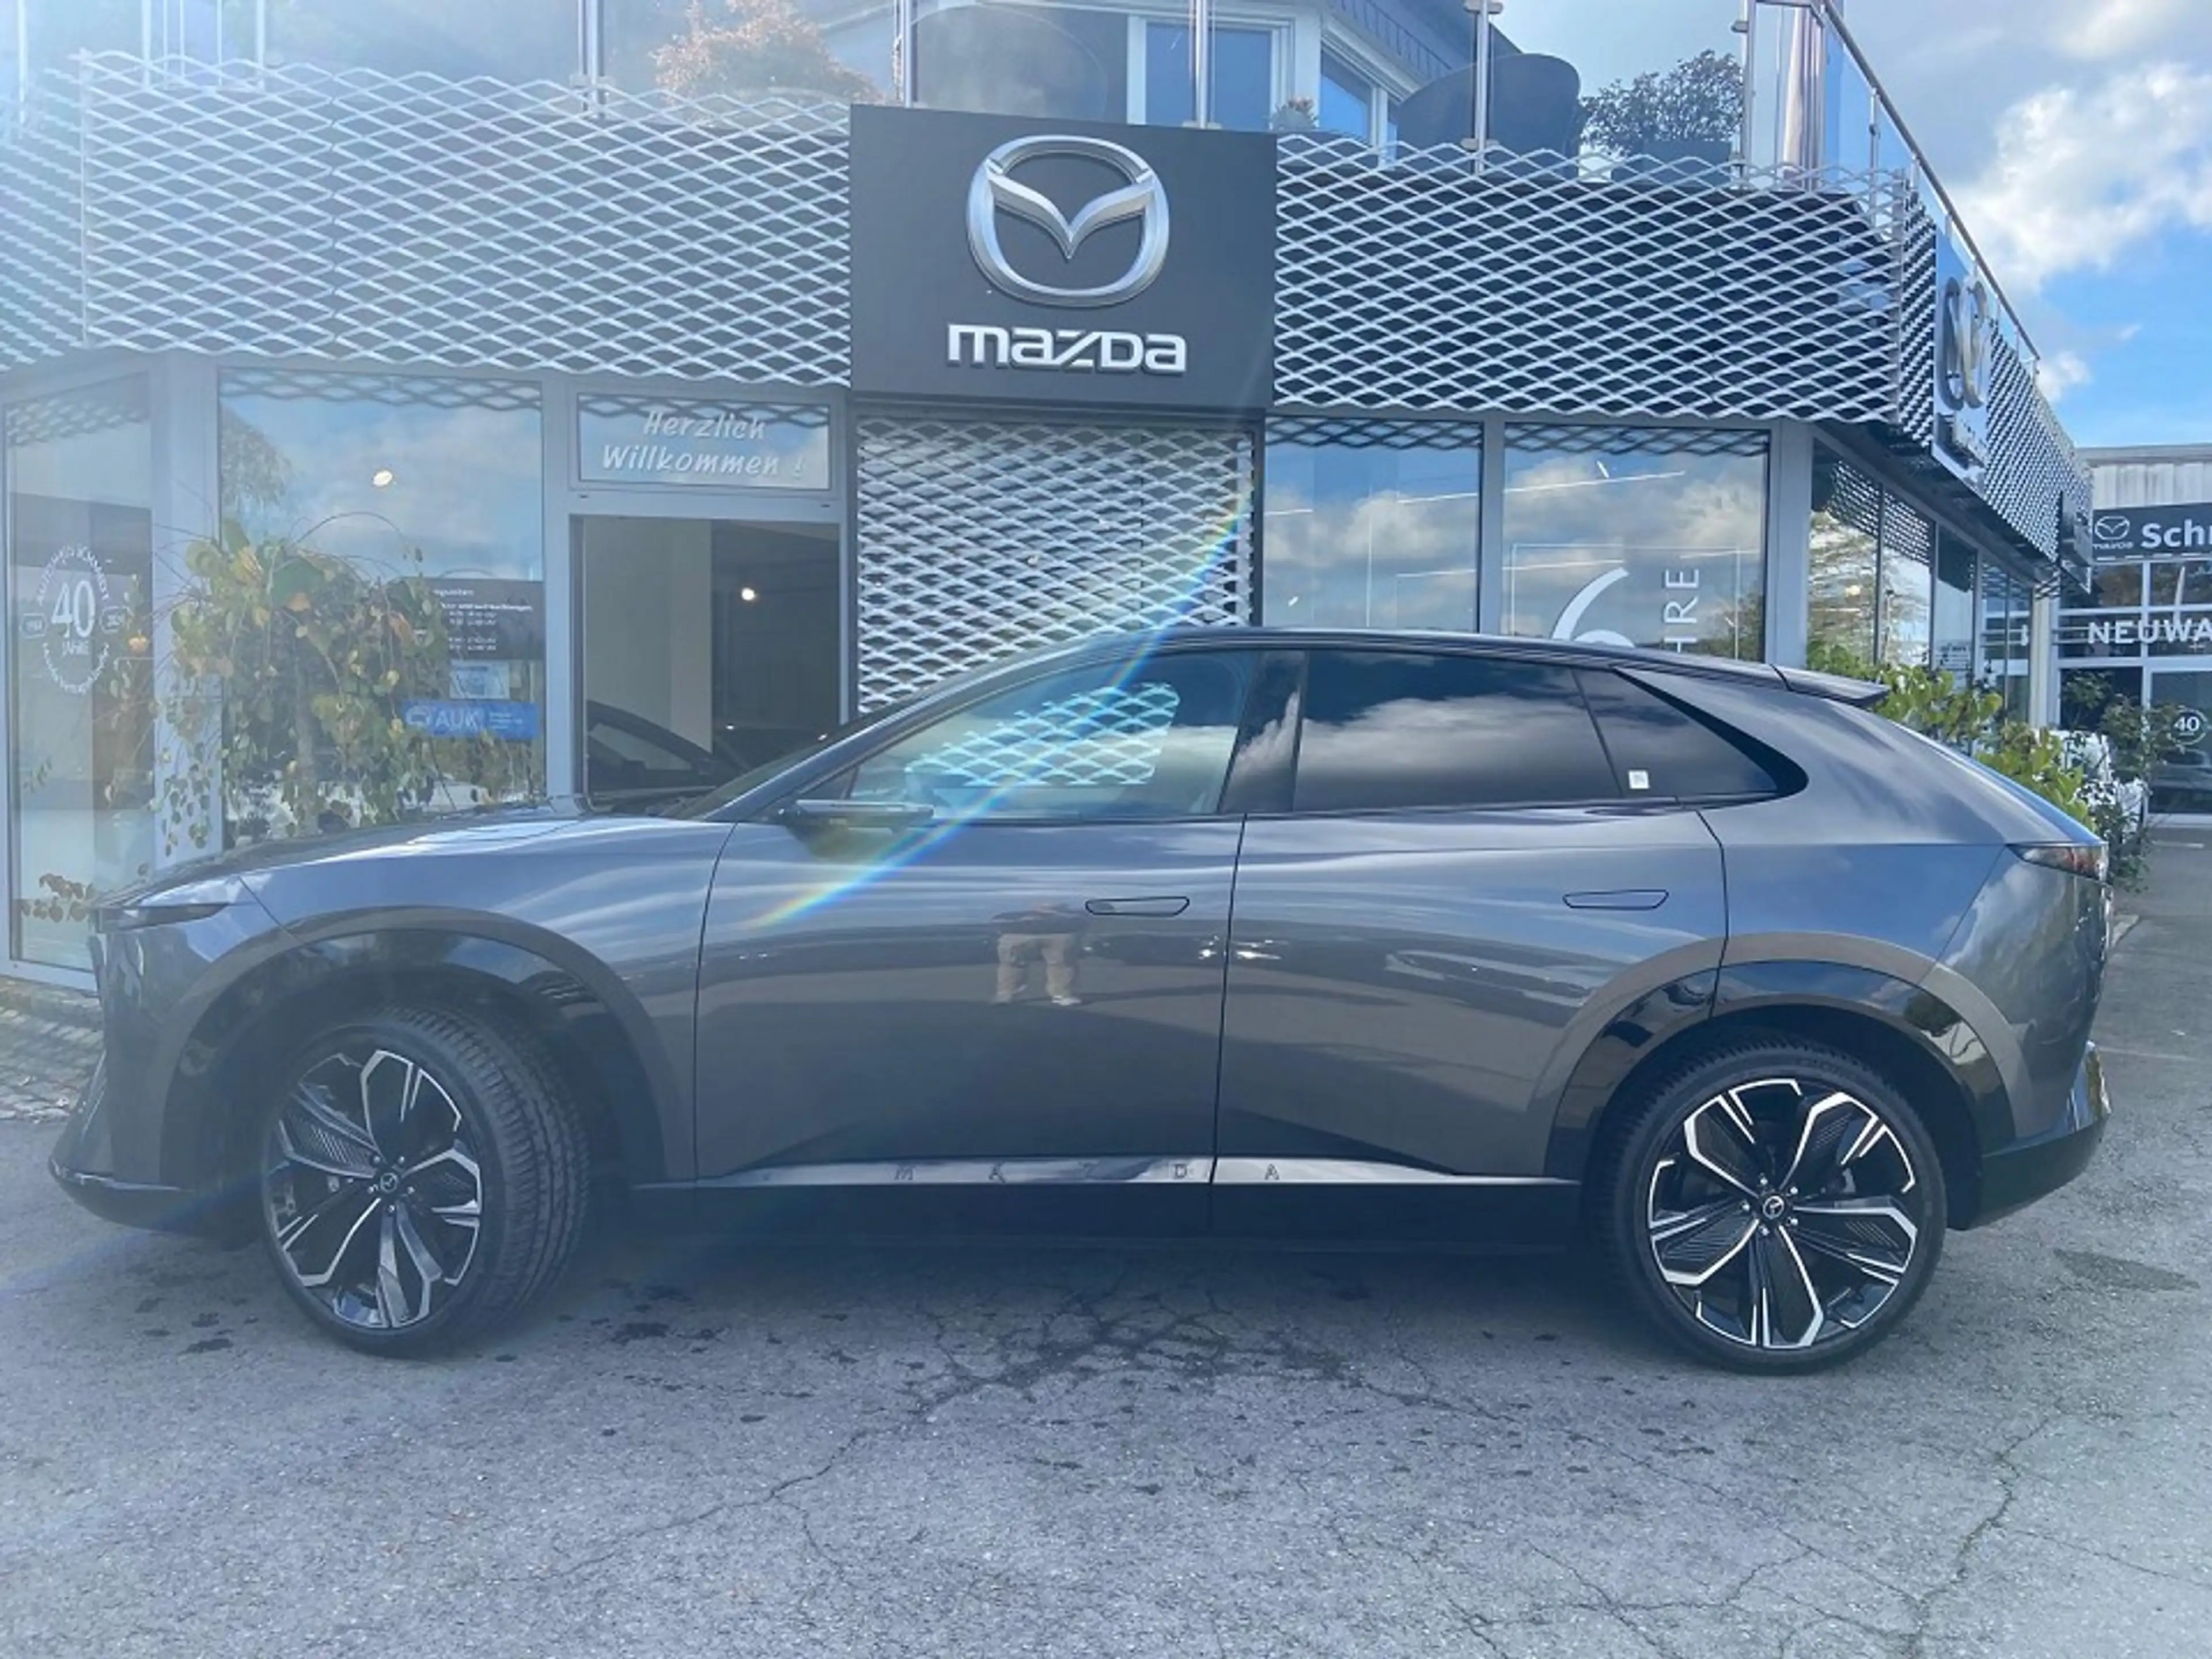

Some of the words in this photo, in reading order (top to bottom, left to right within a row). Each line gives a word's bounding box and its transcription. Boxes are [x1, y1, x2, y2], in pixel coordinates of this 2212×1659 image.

[642, 410, 766, 440] Herzlich
[603, 444, 779, 475] Willkommen
[2141, 518, 2212, 549] Sch
[51, 579, 96, 638] 40
[2088, 617, 2212, 644] NEUWA
[2173, 716, 2200, 732] 40
